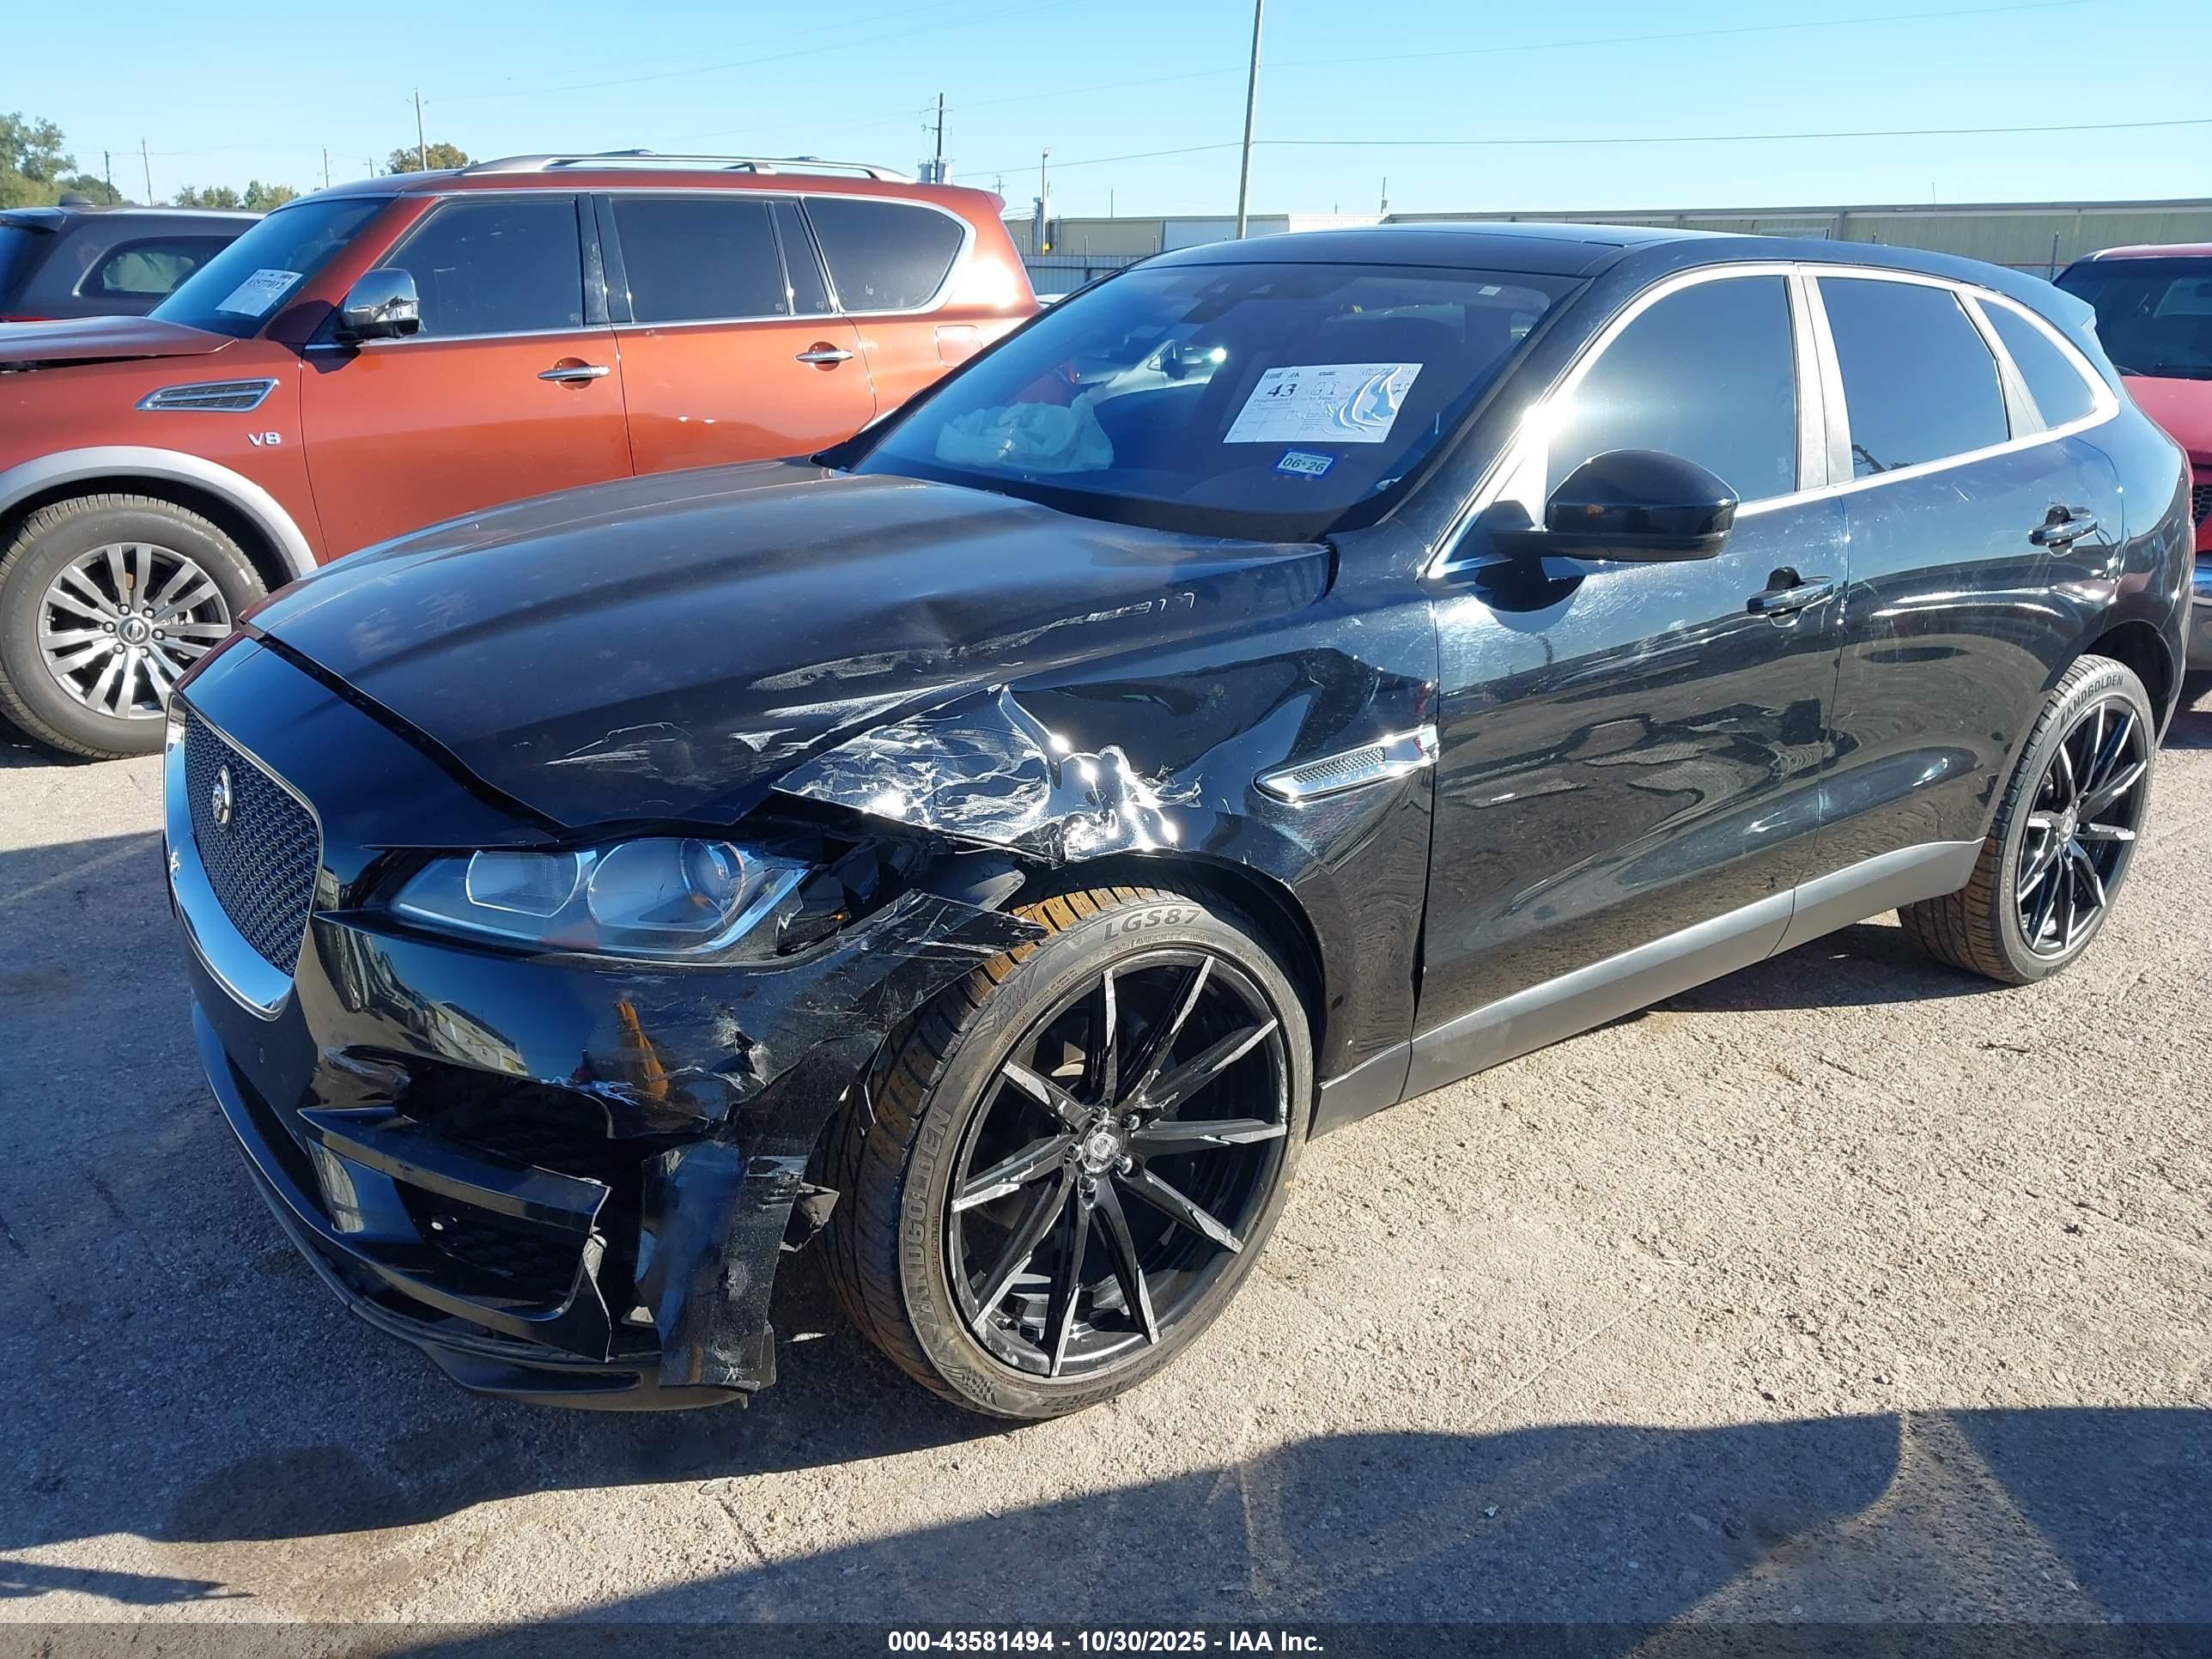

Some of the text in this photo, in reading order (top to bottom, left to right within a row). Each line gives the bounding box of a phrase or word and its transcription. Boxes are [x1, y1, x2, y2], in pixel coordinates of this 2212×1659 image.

[247, 431, 282, 446] V8
[1283, 458, 1327, 472] 06 26
[2060, 674, 2124, 732] LANDGOLDEN
[1103, 908, 1201, 942] LGS87
[1016, 1012, 1031, 1029] LOAD
[904, 1106, 951, 1327] LANDGOLDEN
